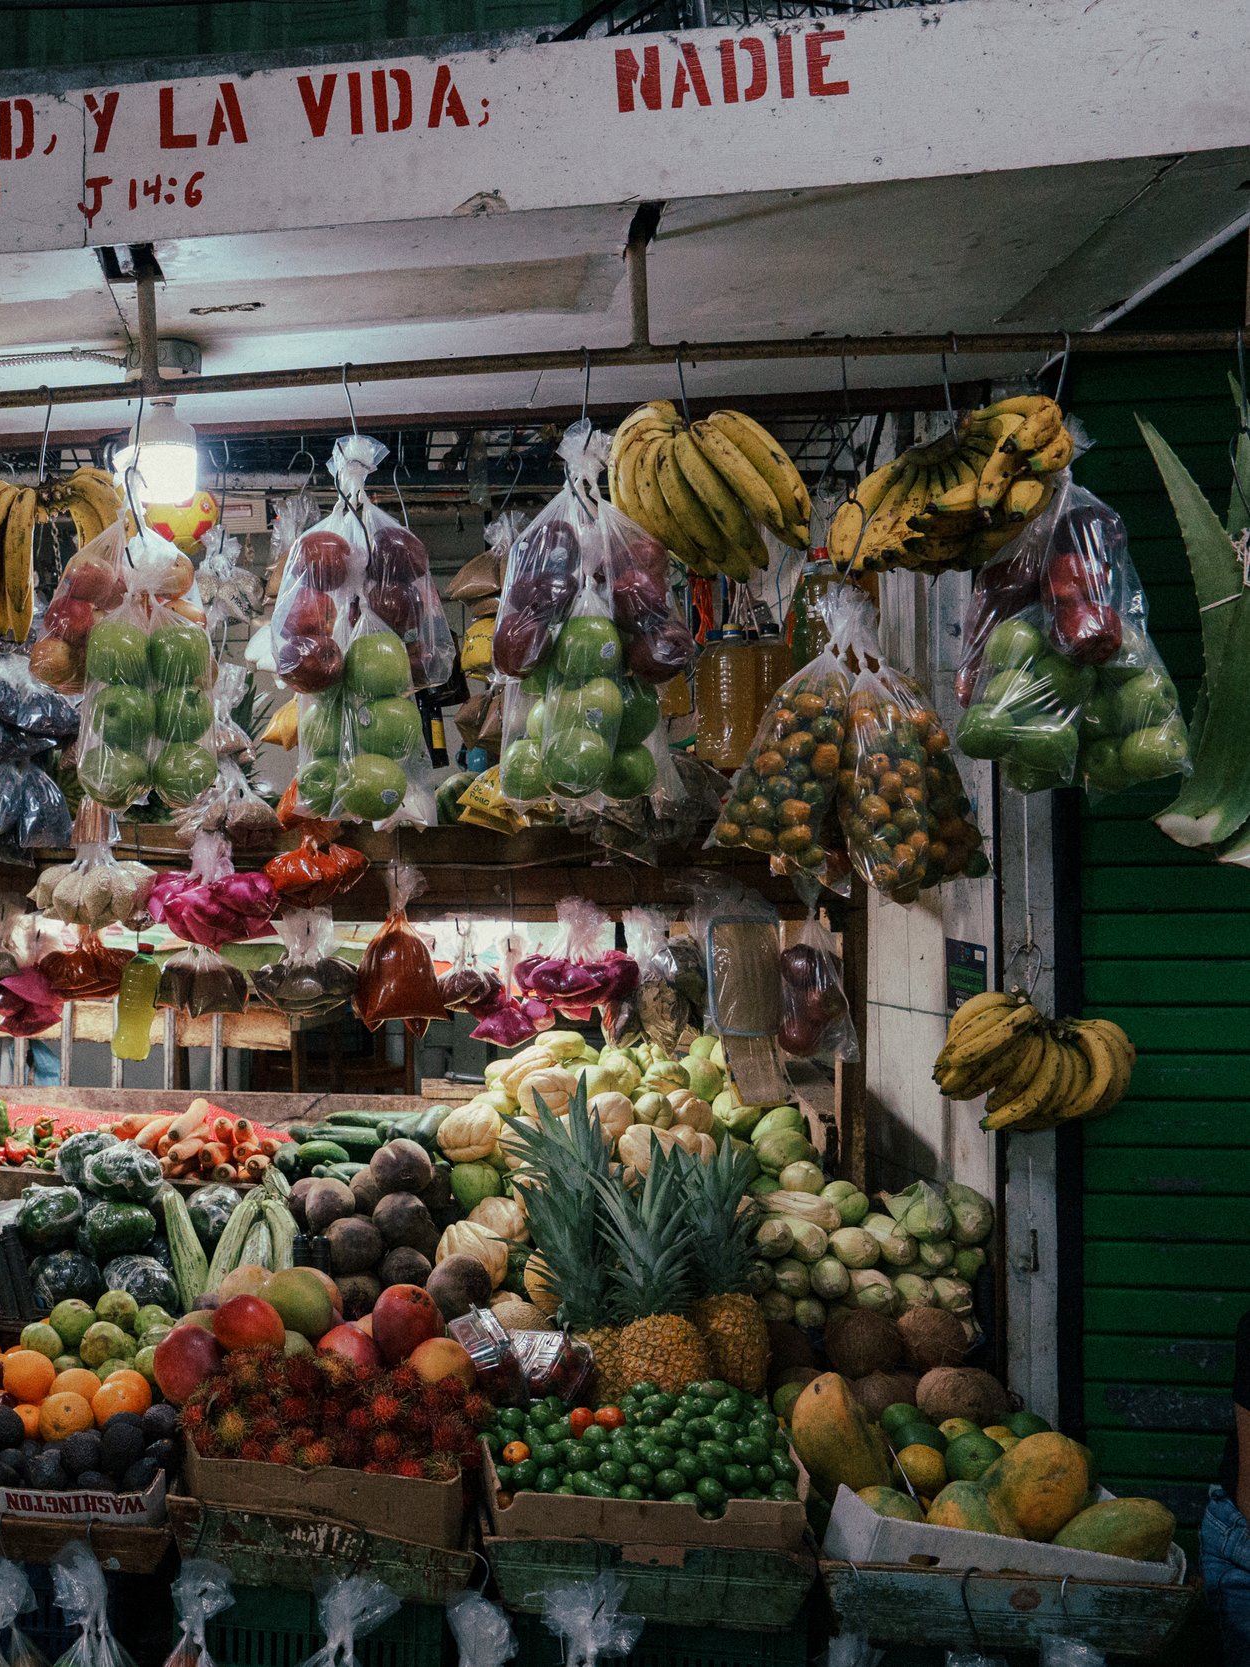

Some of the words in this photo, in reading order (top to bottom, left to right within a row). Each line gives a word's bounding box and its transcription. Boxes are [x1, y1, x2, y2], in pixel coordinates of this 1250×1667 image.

[84, 92, 120, 153] Y
[158, 83, 248, 149] LA
[297, 64, 490, 138] VIDA;
[615, 30, 851, 113] NADIE
[78, 175, 113, 229] J
[129, 171, 206, 211] 14:6
[5, 1492, 148, 1515] WASHINGTON
